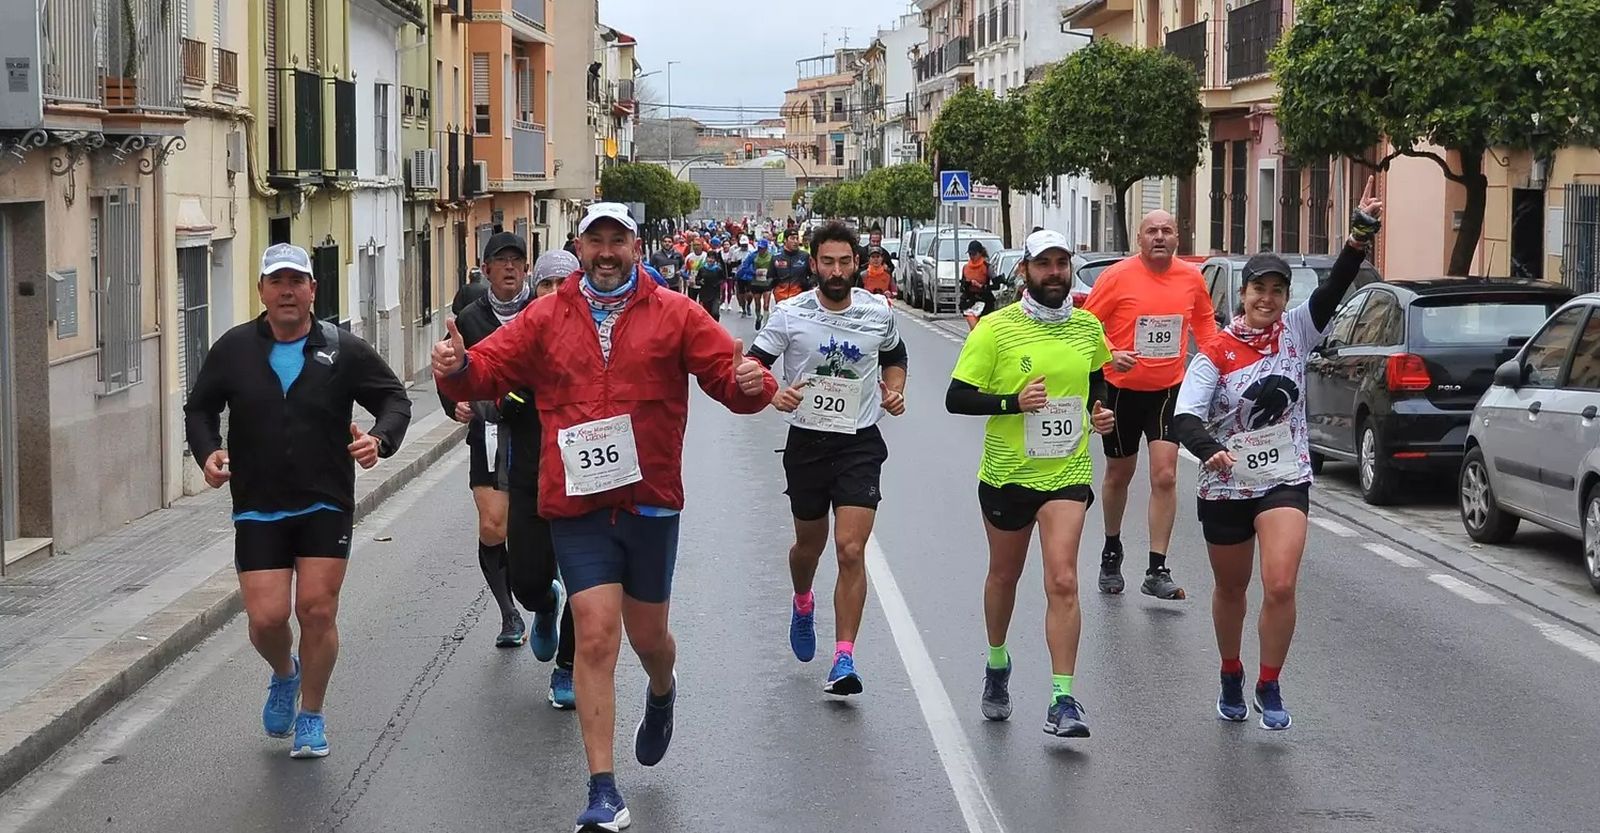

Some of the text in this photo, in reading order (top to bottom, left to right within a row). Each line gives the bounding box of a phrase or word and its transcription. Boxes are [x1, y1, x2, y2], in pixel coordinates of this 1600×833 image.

[1147, 331, 1171, 343] 189
[813, 395, 845, 412] 920
[1041, 420, 1072, 436] 530
[578, 444, 619, 469] 336
[1246, 448, 1279, 469] 899
